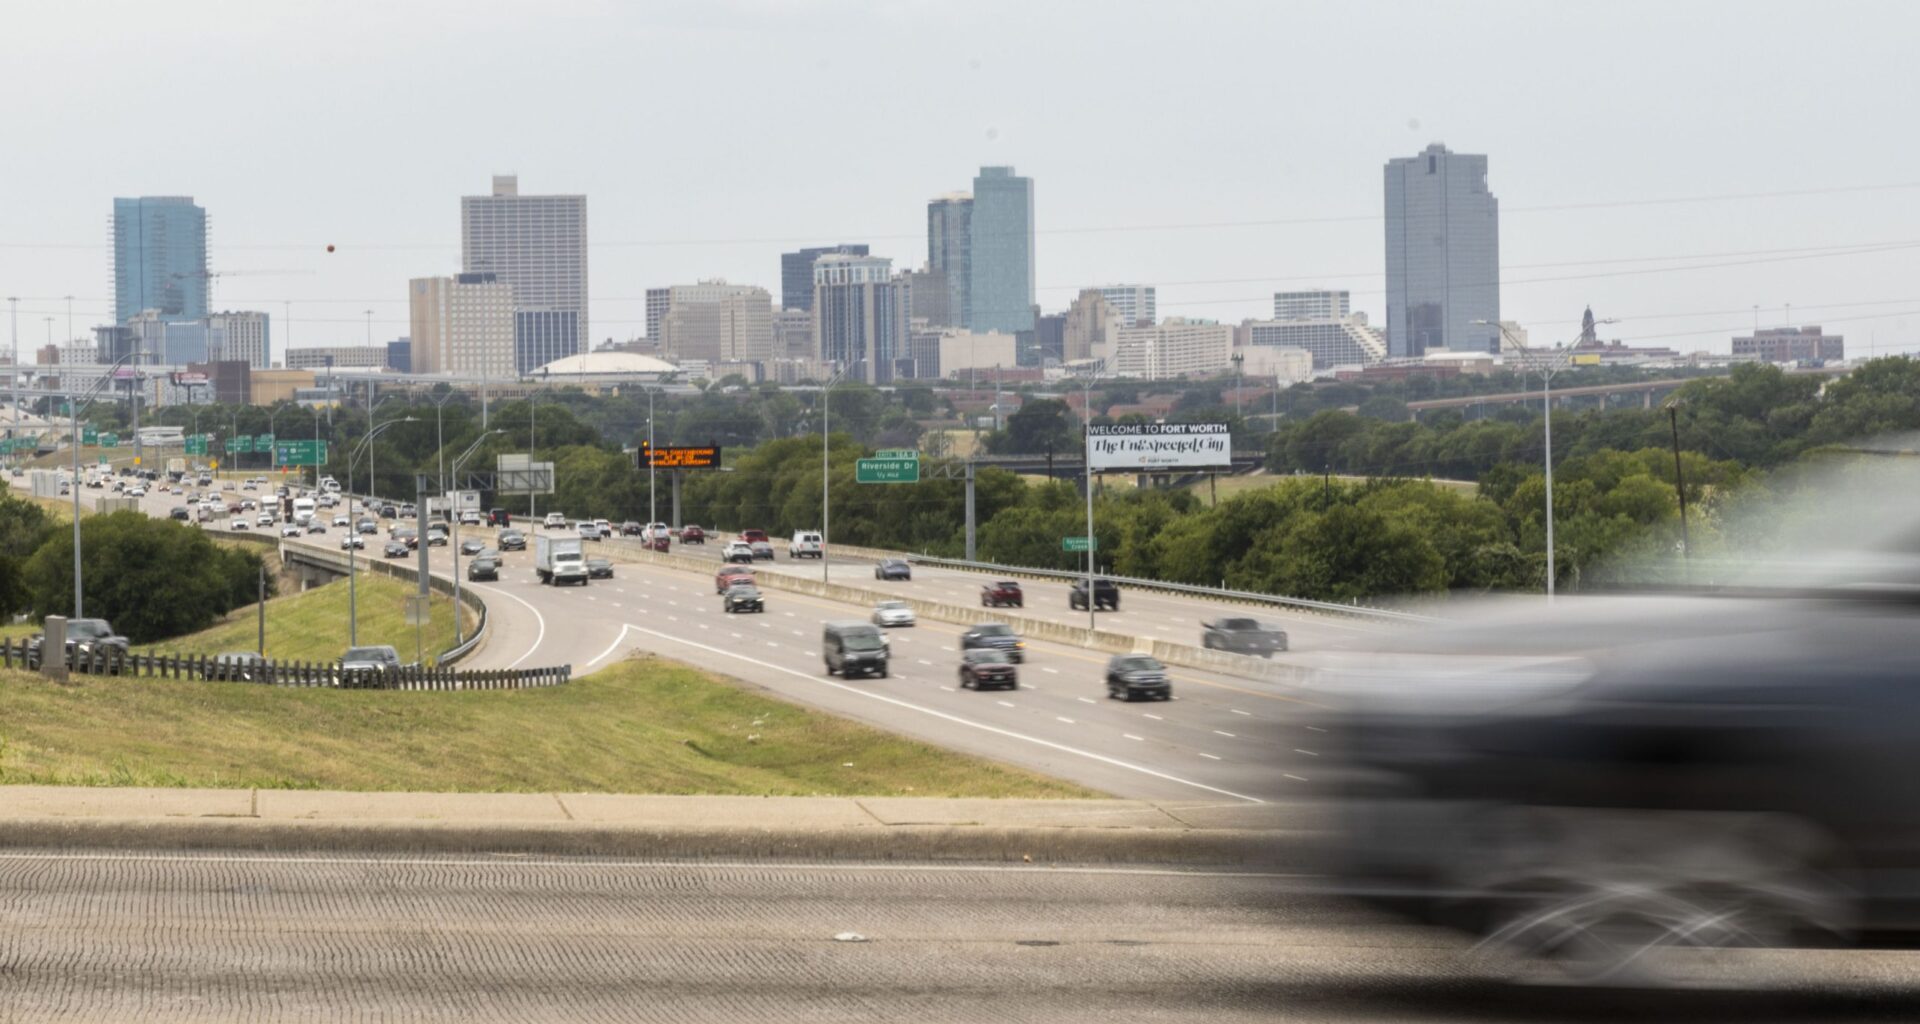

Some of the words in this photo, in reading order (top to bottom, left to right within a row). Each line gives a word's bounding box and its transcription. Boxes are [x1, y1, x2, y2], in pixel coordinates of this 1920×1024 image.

[1090, 425, 1142, 435] WELCOME
[1144, 425, 1159, 434] TO
[1160, 424, 1187, 433] FORT
[1188, 423, 1227, 433] WORTH
[1093, 438, 1119, 454] The
[1199, 437, 1224, 452] City
